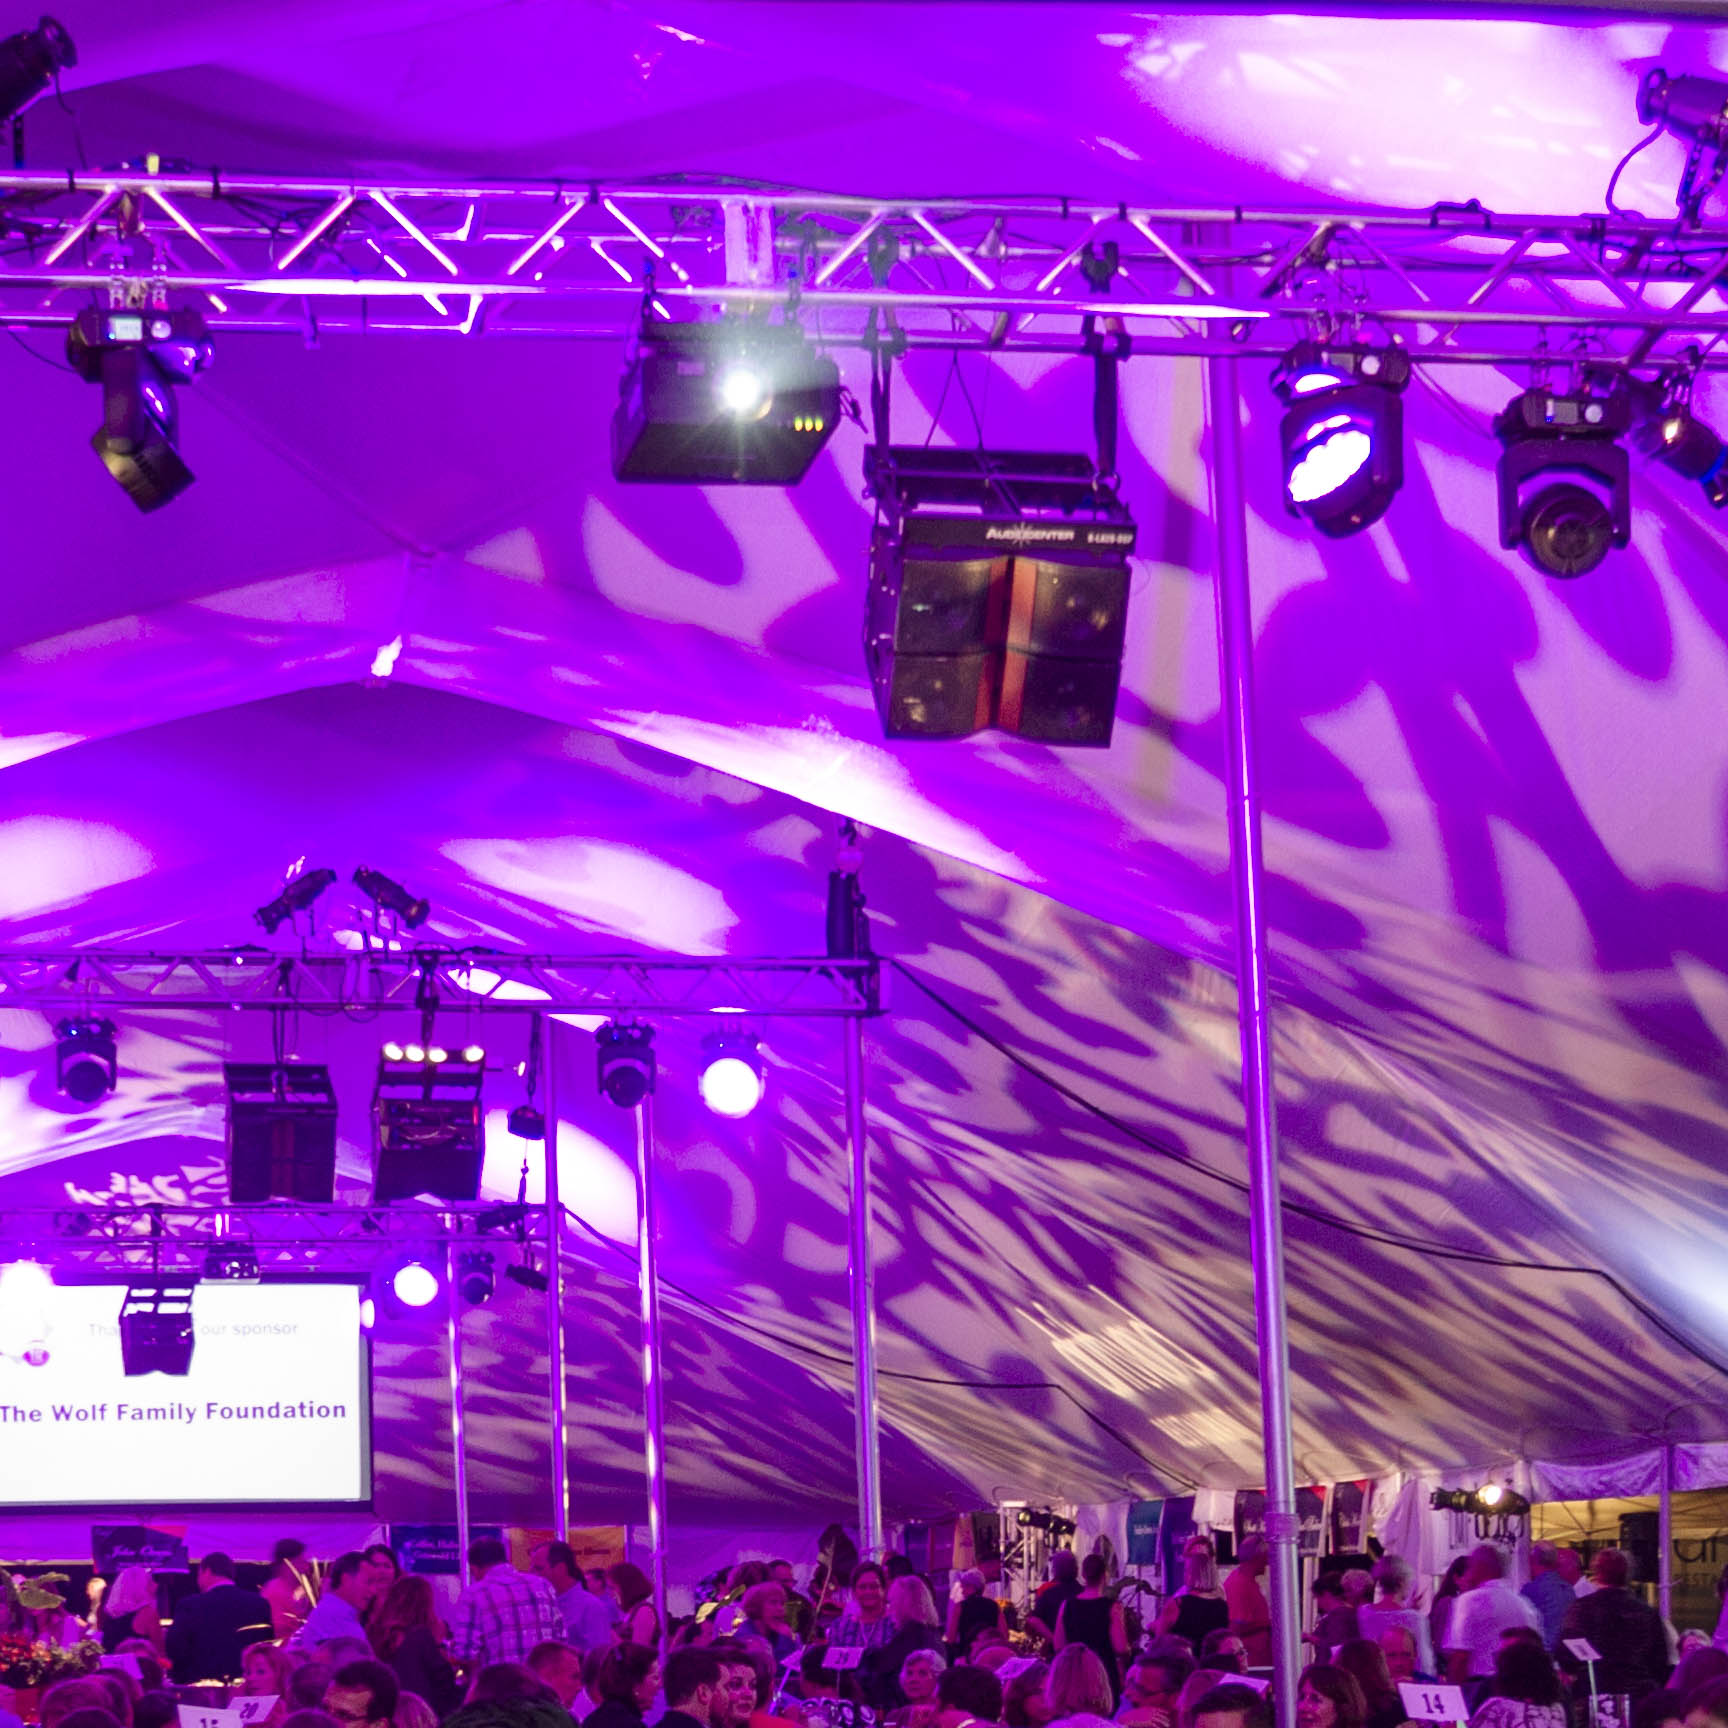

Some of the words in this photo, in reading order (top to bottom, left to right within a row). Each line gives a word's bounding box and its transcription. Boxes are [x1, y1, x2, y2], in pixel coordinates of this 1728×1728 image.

[233, 1322, 298, 1338] sponsor
[0, 1405, 42, 1423] The
[52, 1403, 107, 1422] Wolf
[117, 1402, 196, 1424] Family
[206, 1401, 347, 1420] Foundation
[1422, 1693, 1445, 1714] 14
